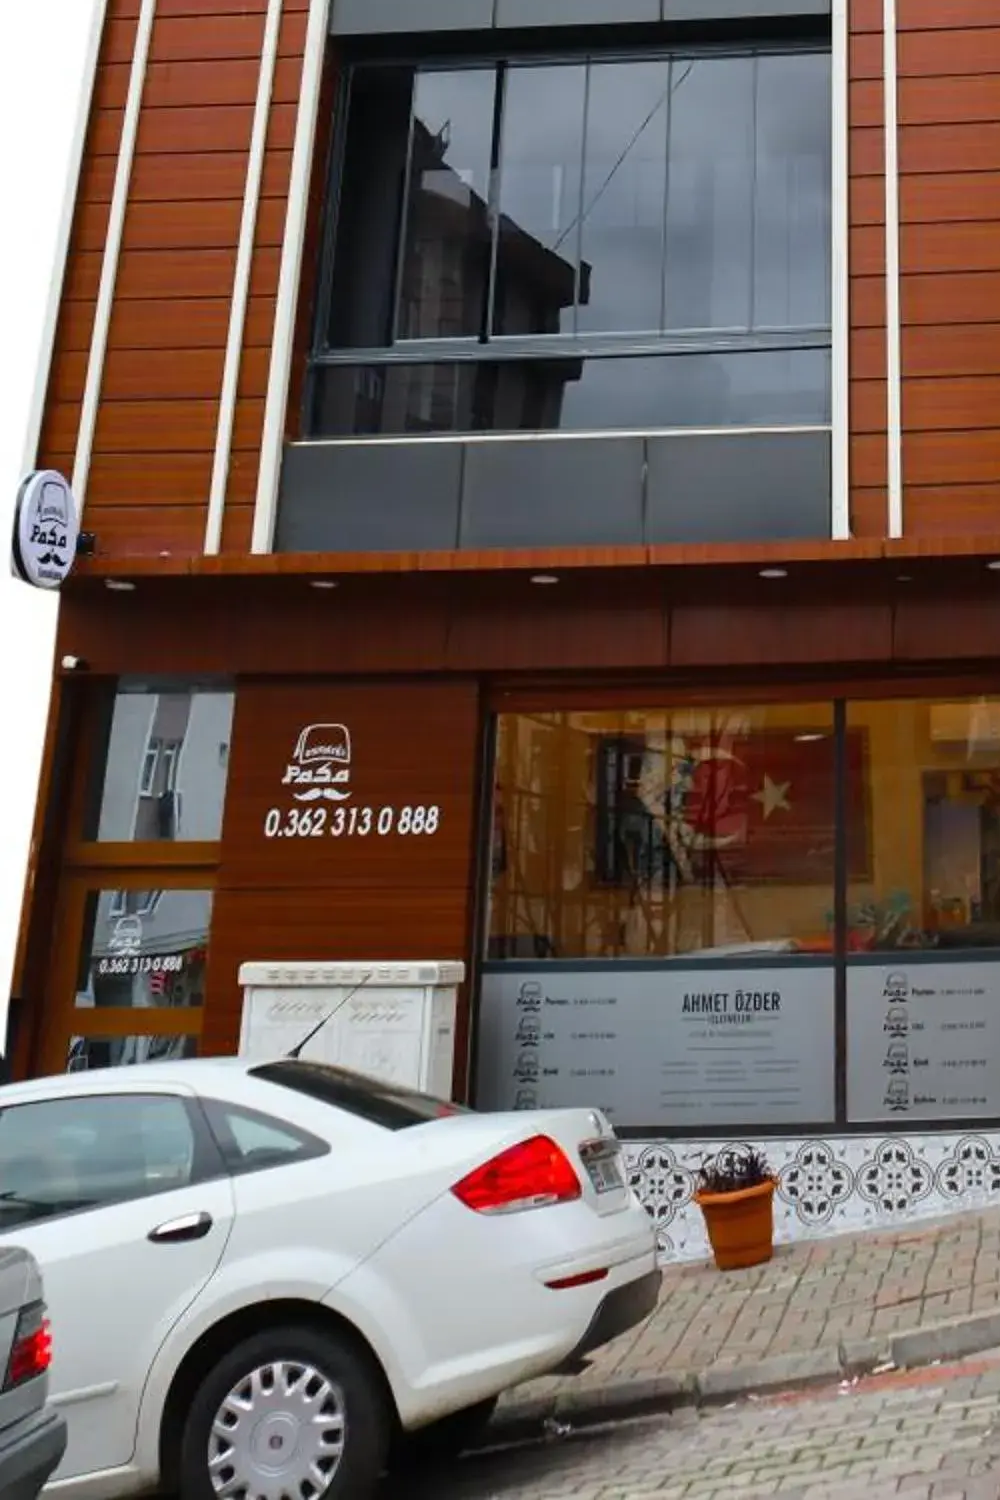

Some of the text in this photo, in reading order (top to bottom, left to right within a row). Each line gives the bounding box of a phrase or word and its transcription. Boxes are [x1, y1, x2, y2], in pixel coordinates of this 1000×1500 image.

[264, 805, 439, 837] 0.362 313 0 888
[682, 990, 781, 1012] AHMET ÖZDER
